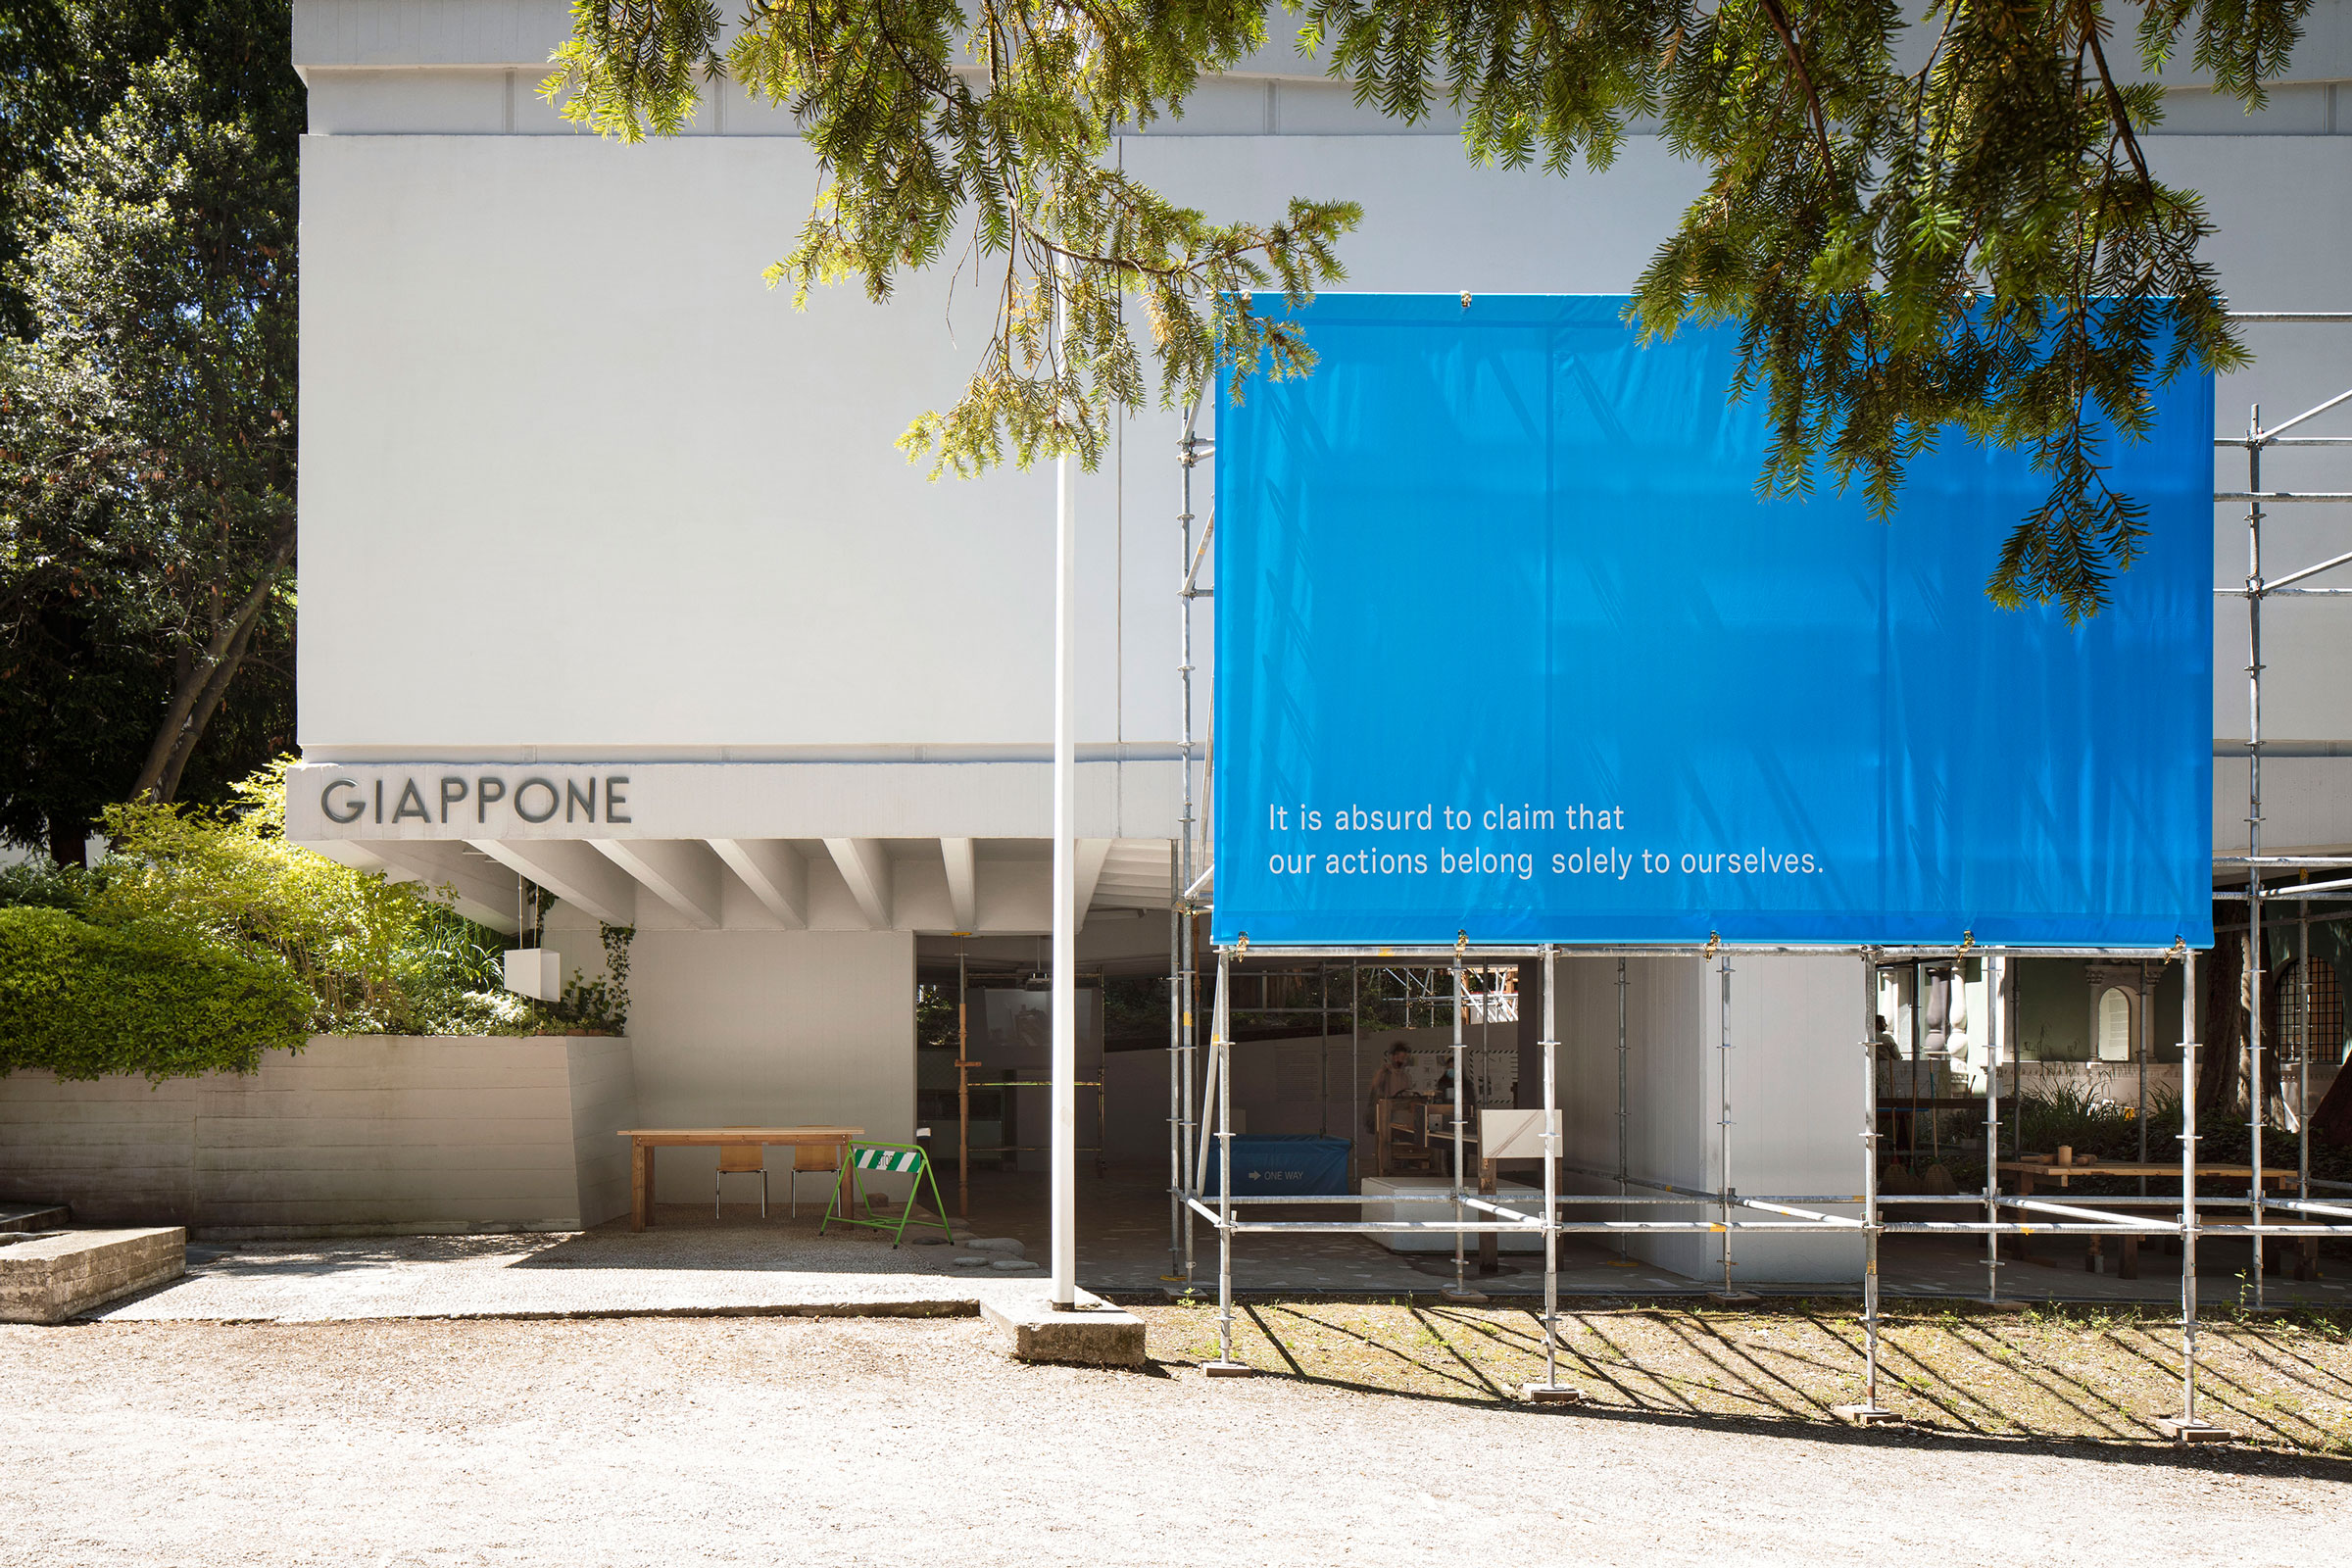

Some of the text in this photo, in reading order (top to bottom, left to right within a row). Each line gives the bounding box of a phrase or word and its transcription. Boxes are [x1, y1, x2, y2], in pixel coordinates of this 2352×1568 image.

[320, 777, 632, 824] GIAPPONE
[1269, 803, 1625, 831] It is absurd to claim that
[1269, 847, 1825, 880] our actions belong solely to ourselves.
[1264, 1171, 1303, 1181] ONE WAY
